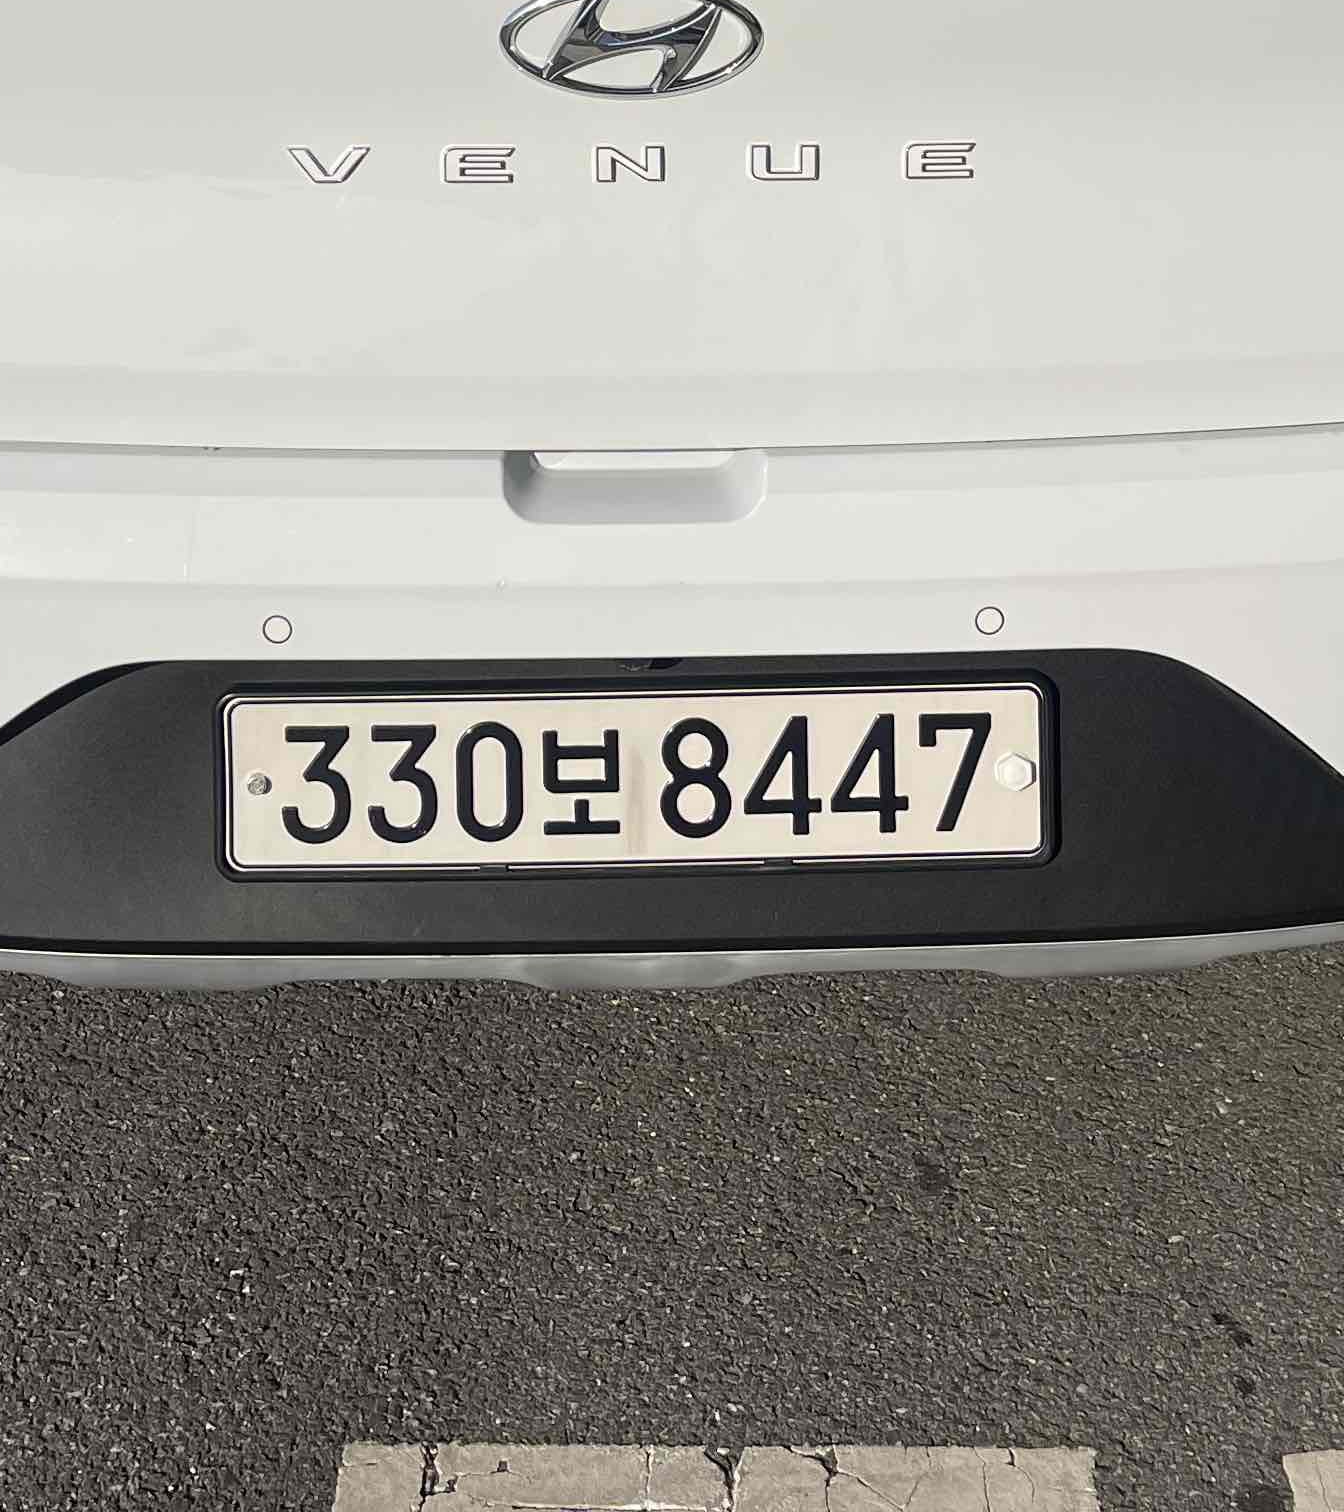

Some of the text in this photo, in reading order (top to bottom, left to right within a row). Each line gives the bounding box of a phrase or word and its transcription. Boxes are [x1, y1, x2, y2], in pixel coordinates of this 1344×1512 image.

[286, 139, 978, 184] VENUE
[281, 711, 993, 845] 330보 8447
